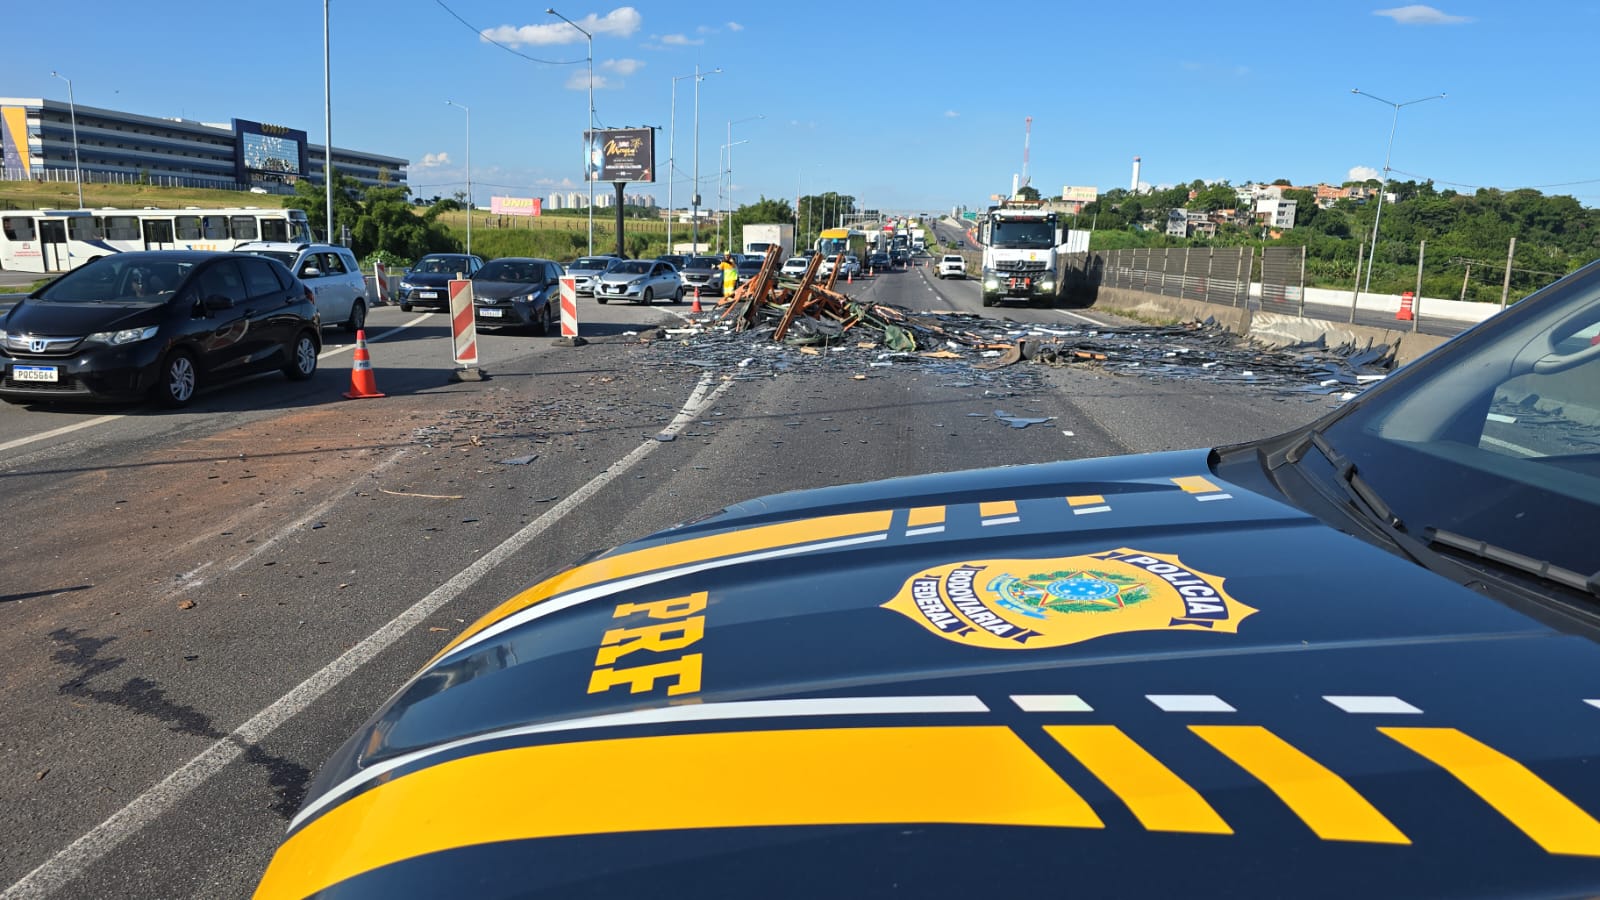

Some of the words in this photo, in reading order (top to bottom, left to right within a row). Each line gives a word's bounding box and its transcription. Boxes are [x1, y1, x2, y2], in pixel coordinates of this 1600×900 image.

[262, 123, 289, 135] UNIP
[502, 198, 534, 208] UNIP
[913, 580, 960, 630] FEDERAL
[947, 570, 1014, 636] RODOVIARIA
[1124, 556, 1225, 615] POLICIA
[586, 591, 709, 697] PRF
